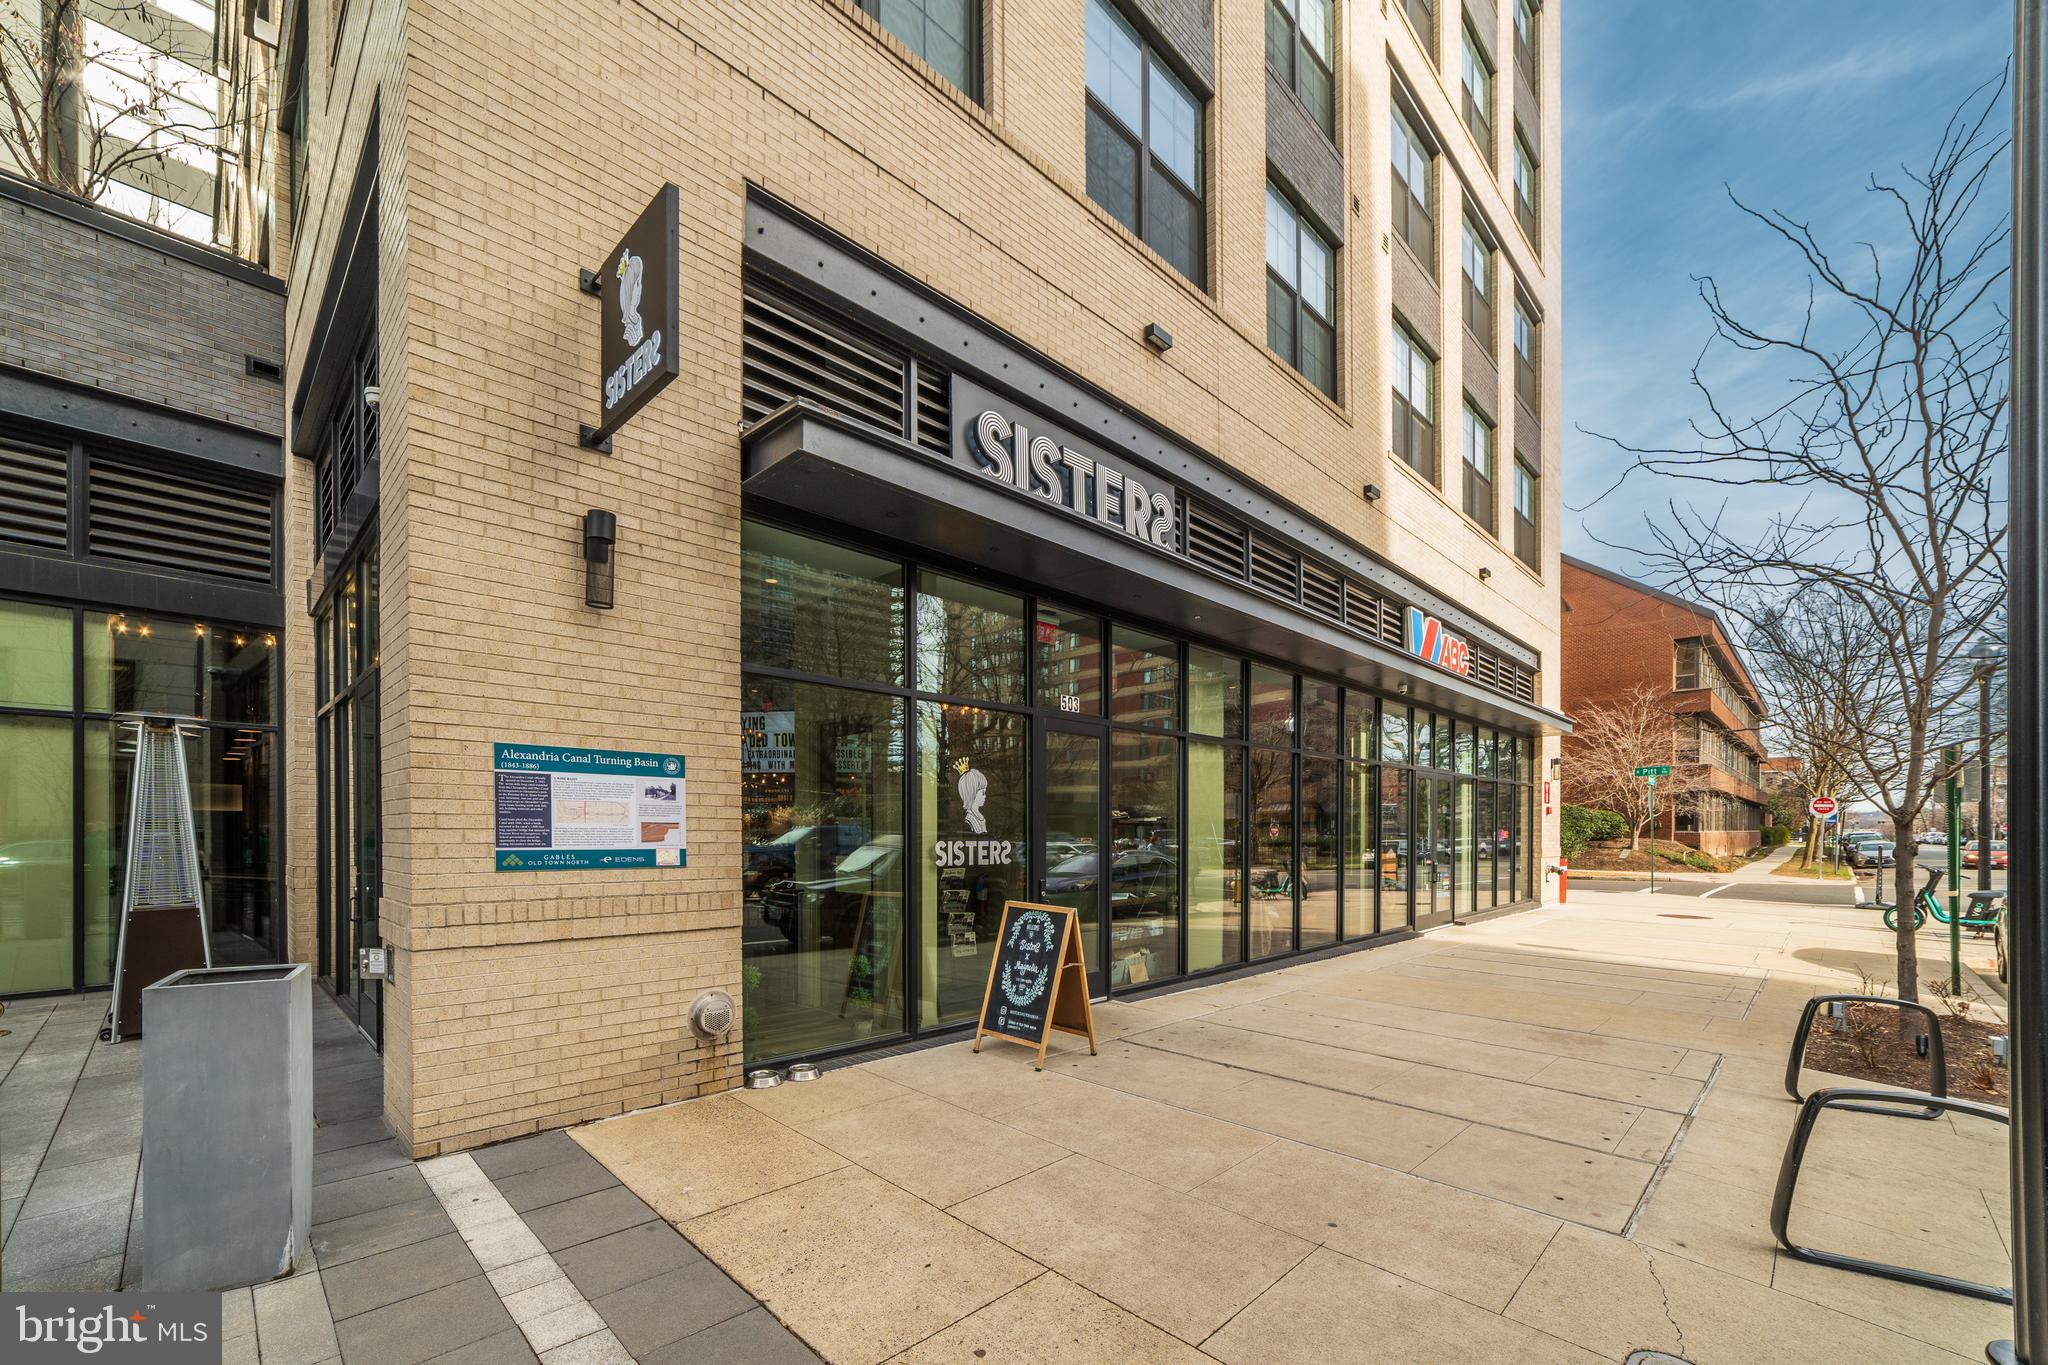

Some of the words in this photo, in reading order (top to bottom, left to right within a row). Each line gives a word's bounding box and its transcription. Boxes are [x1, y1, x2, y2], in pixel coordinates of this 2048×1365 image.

[605, 329, 662, 410] SISTERS
[973, 410, 1174, 552] SISTERS
[1440, 634, 1470, 676] ABC
[1061, 695, 1079, 712] 503
[501, 749, 560, 762] Alexandria
[562, 752, 591, 764] Canal
[593, 754, 632, 768] Turning
[634, 757, 659, 768] Basin
[501, 762, 540, 770] (1843-1886)
[935, 839, 1012, 867] SISTERS
